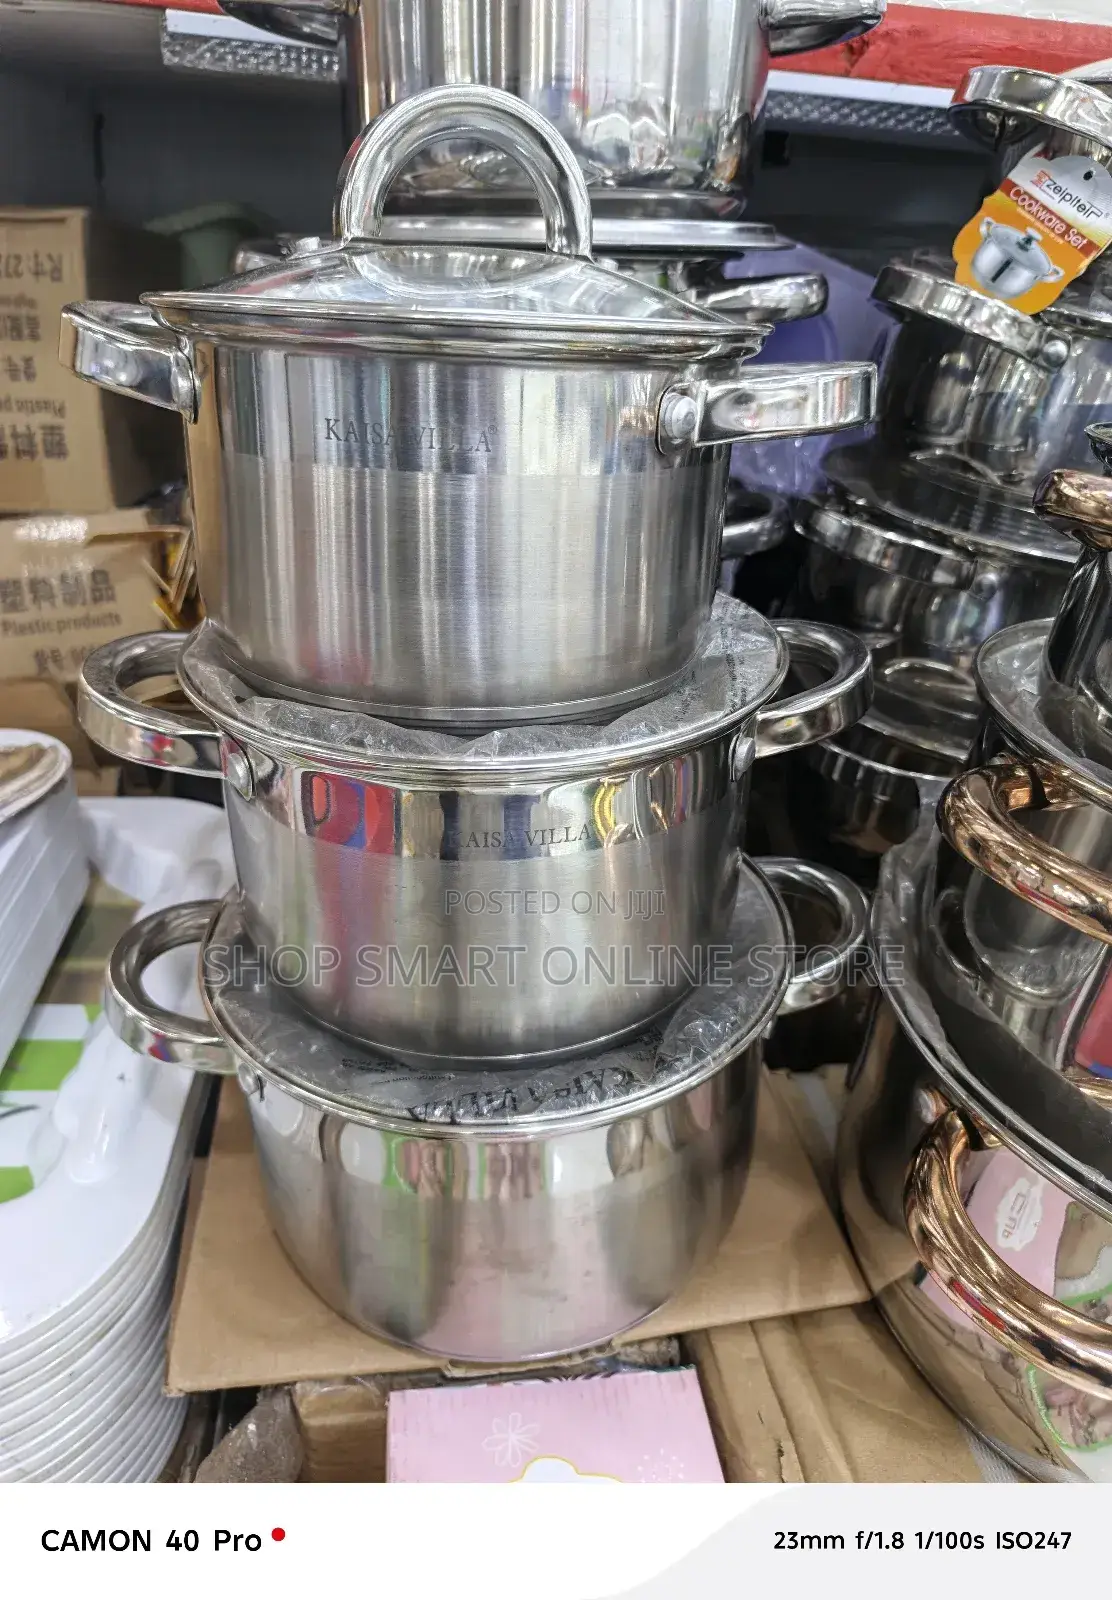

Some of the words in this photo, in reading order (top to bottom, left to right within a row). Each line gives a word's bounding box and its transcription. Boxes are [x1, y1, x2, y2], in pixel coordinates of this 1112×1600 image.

[1009, 186, 1067, 235] Cookware
[1064, 228, 1088, 250] Set
[324, 417, 397, 446] KAISA
[1, 618, 54, 637] Plastic
[56, 612, 122, 633] products
[523, 823, 594, 847] VILLA
